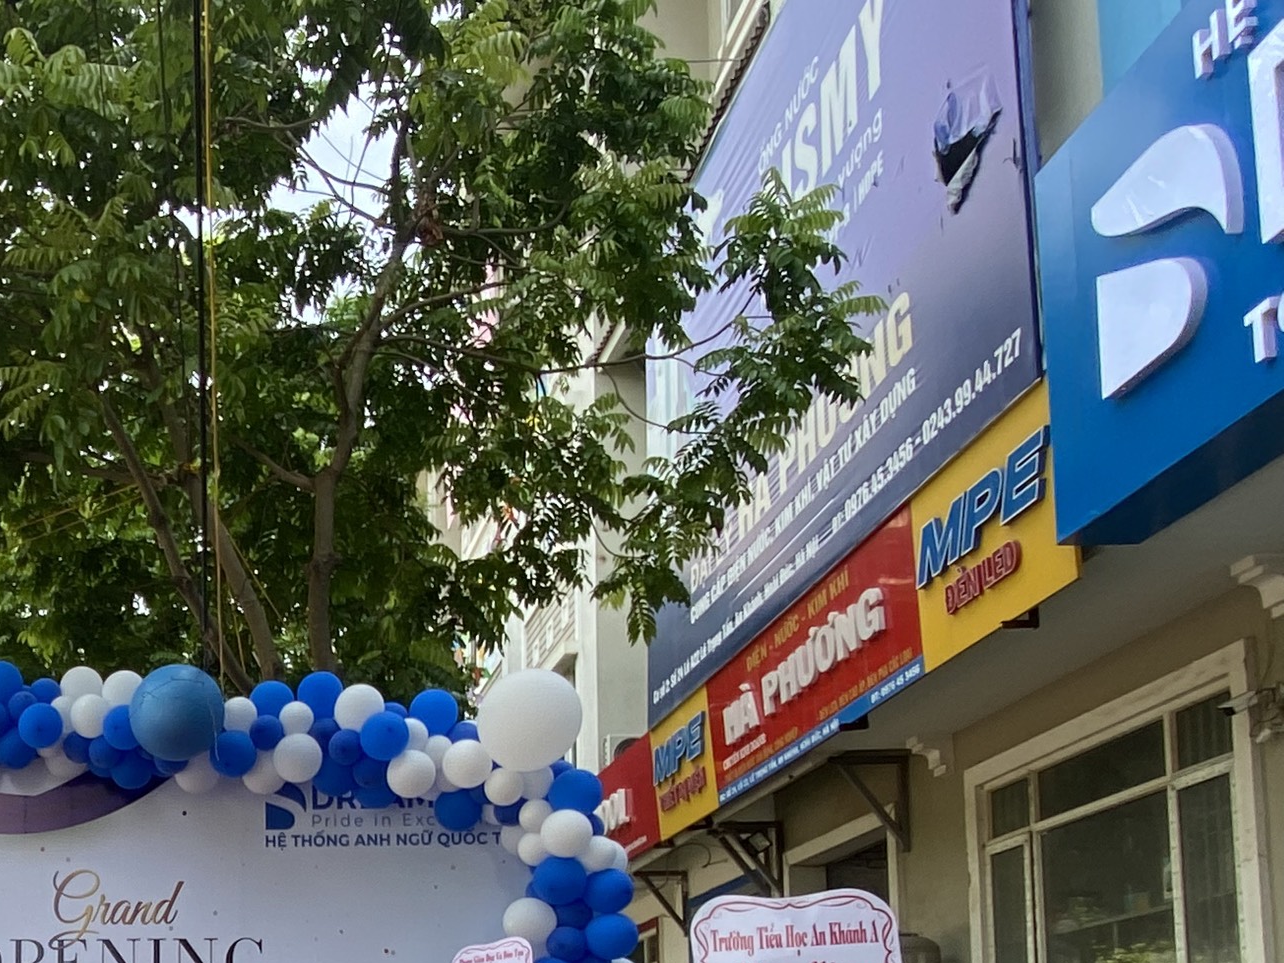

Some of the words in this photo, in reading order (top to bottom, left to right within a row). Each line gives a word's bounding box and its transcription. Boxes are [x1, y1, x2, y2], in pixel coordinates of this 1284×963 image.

[922, 327, 1022, 446] 0243.99.44.727
[916, 424, 1050, 590] MPE
[982, 540, 1021, 591] LED
[653, 711, 705, 787] MPE
[265, 832, 287, 851] HỆ
[291, 829, 350, 848] THỐNG
[356, 834, 390, 847] ANH
[396, 830, 433, 847] NGỮ
[312, 812, 364, 828] Pride
[374, 813, 392, 828] in
[48, 869, 185, 950] Grand
[710, 929, 754, 957] Trường
[757, 923, 783, 950] Tiểu
[785, 924, 807, 957] Học
[810, 923, 827, 947] An
[828, 920, 866, 945] Khánh
[869, 920, 879, 943] A
